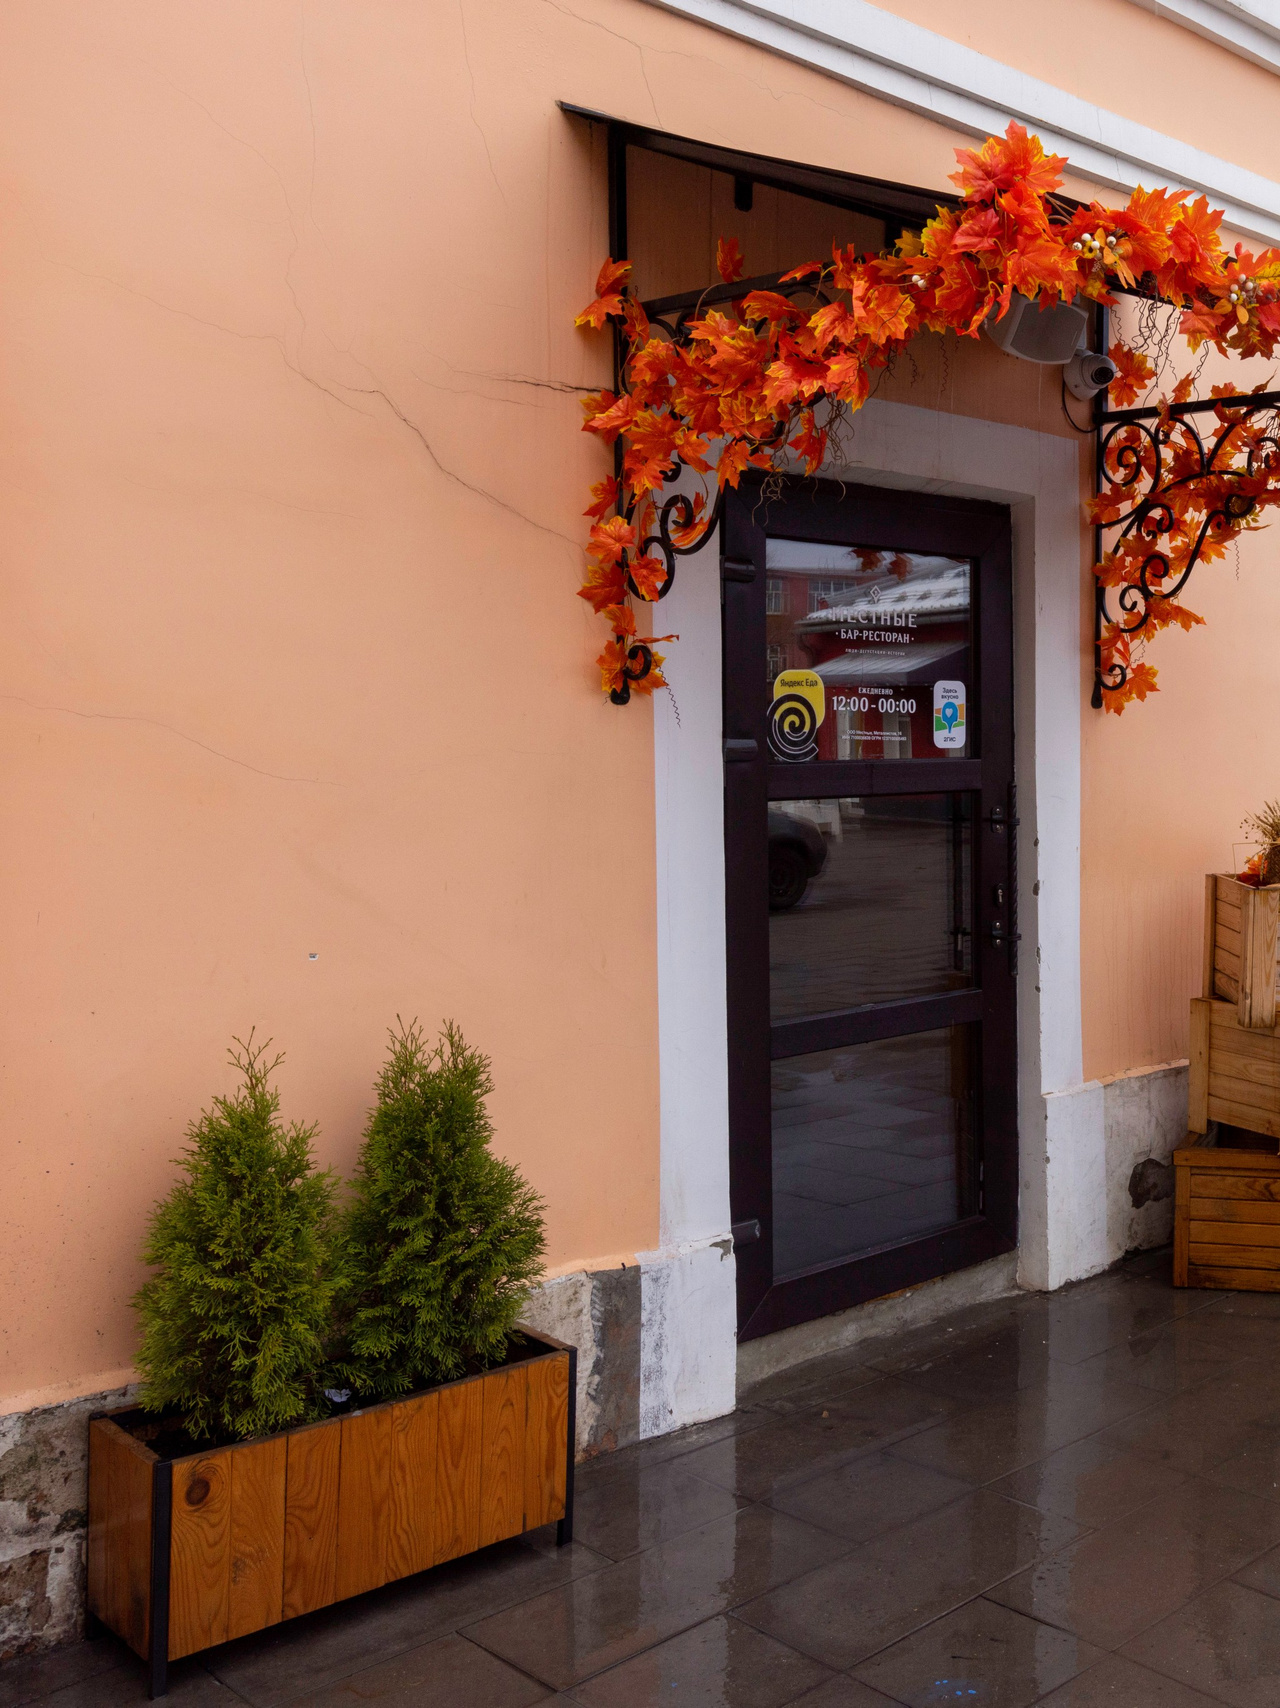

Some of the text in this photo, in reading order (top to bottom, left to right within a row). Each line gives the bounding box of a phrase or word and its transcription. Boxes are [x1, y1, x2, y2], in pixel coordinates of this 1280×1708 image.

[840, 629, 910, 644] БАР-РЕСТОРАН
[780, 679, 818, 688] Яндекс Еда
[858, 687, 893, 696] ЕЖЕДНЕВНО
[832, 695, 868, 713] 12:00
[878, 698, 917, 714] 00:00
